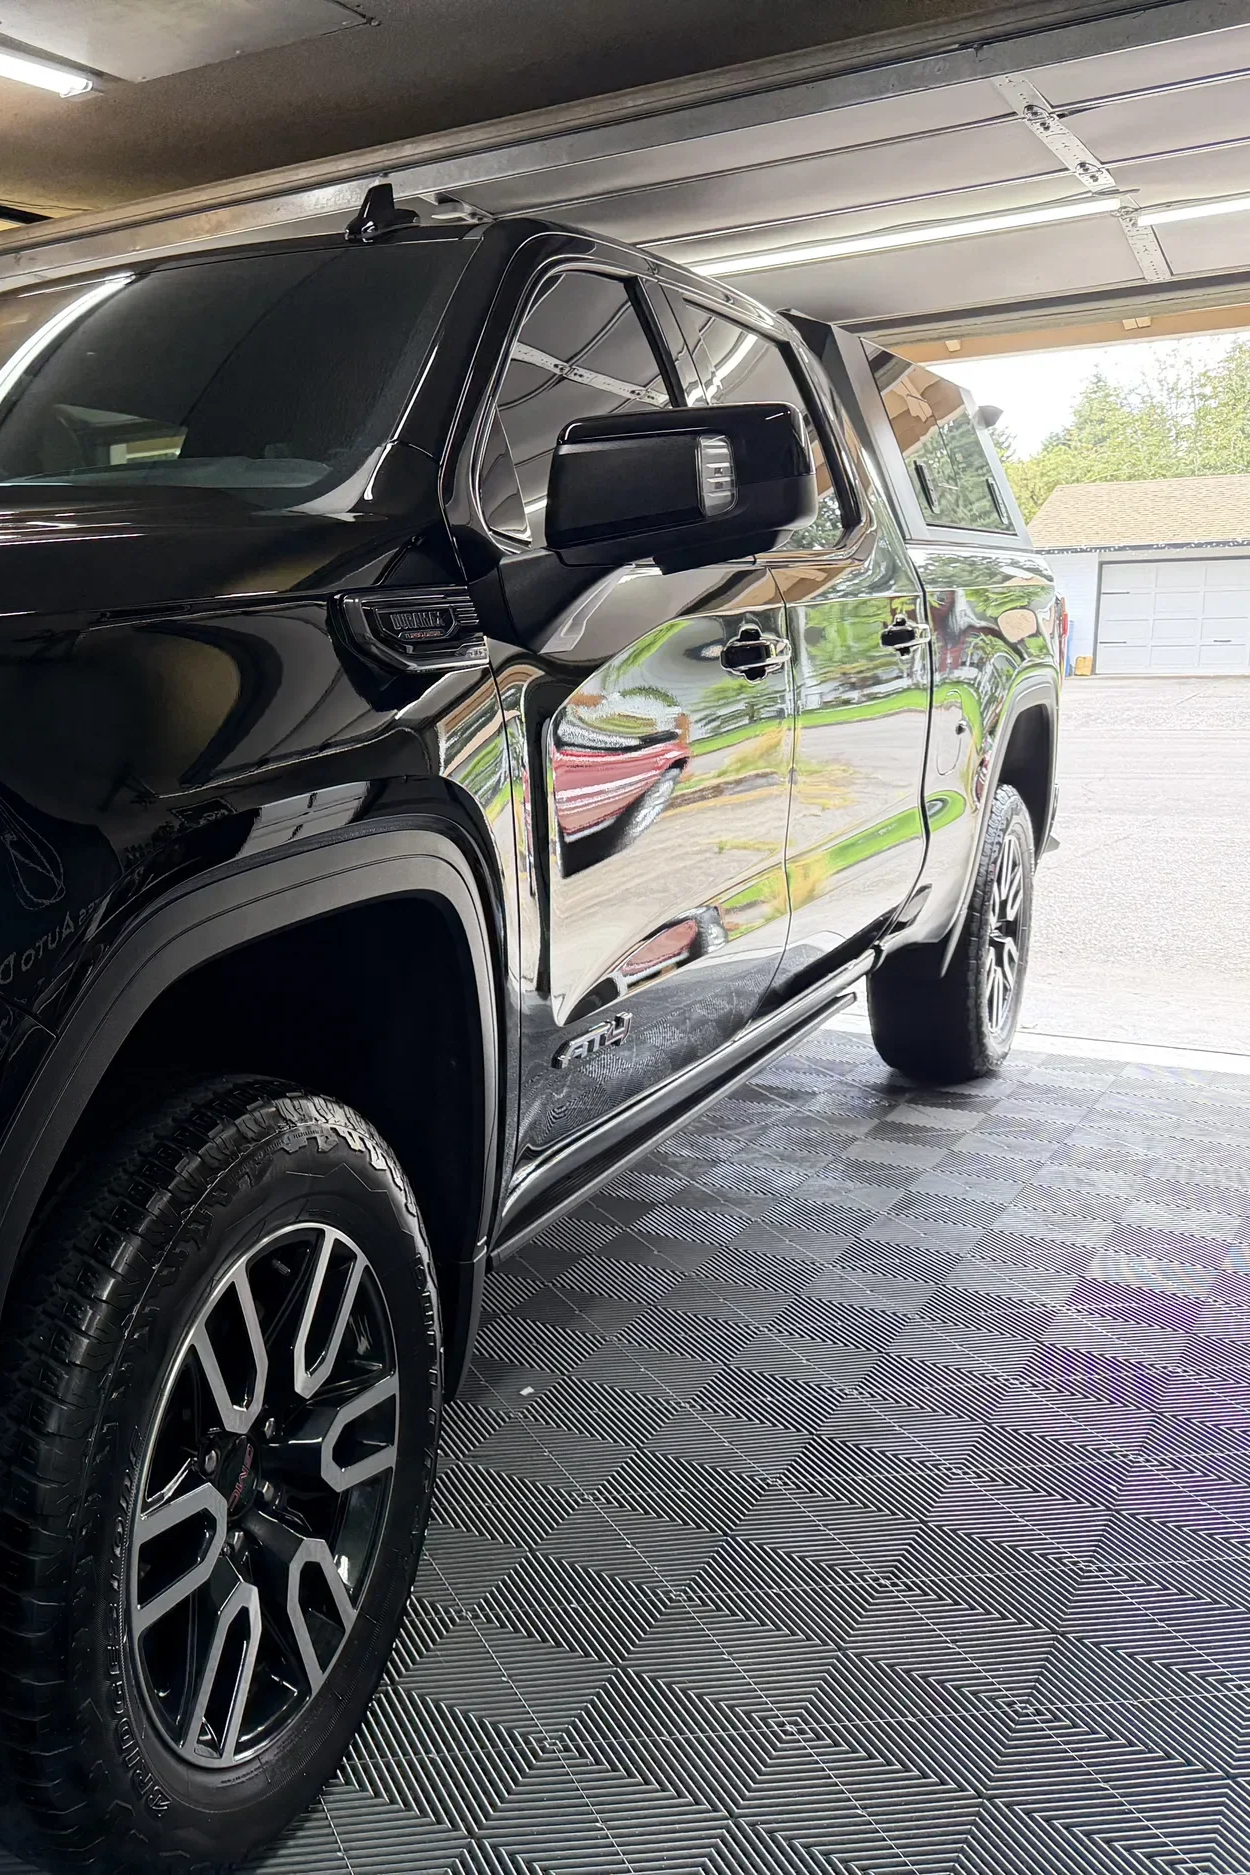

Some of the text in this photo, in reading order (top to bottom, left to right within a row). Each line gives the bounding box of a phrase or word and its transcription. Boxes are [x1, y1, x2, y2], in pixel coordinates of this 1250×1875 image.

[390, 611, 446, 631] DURAMAX
[551, 1011, 633, 1069] AT4
[228, 1443, 254, 1512] GMC
